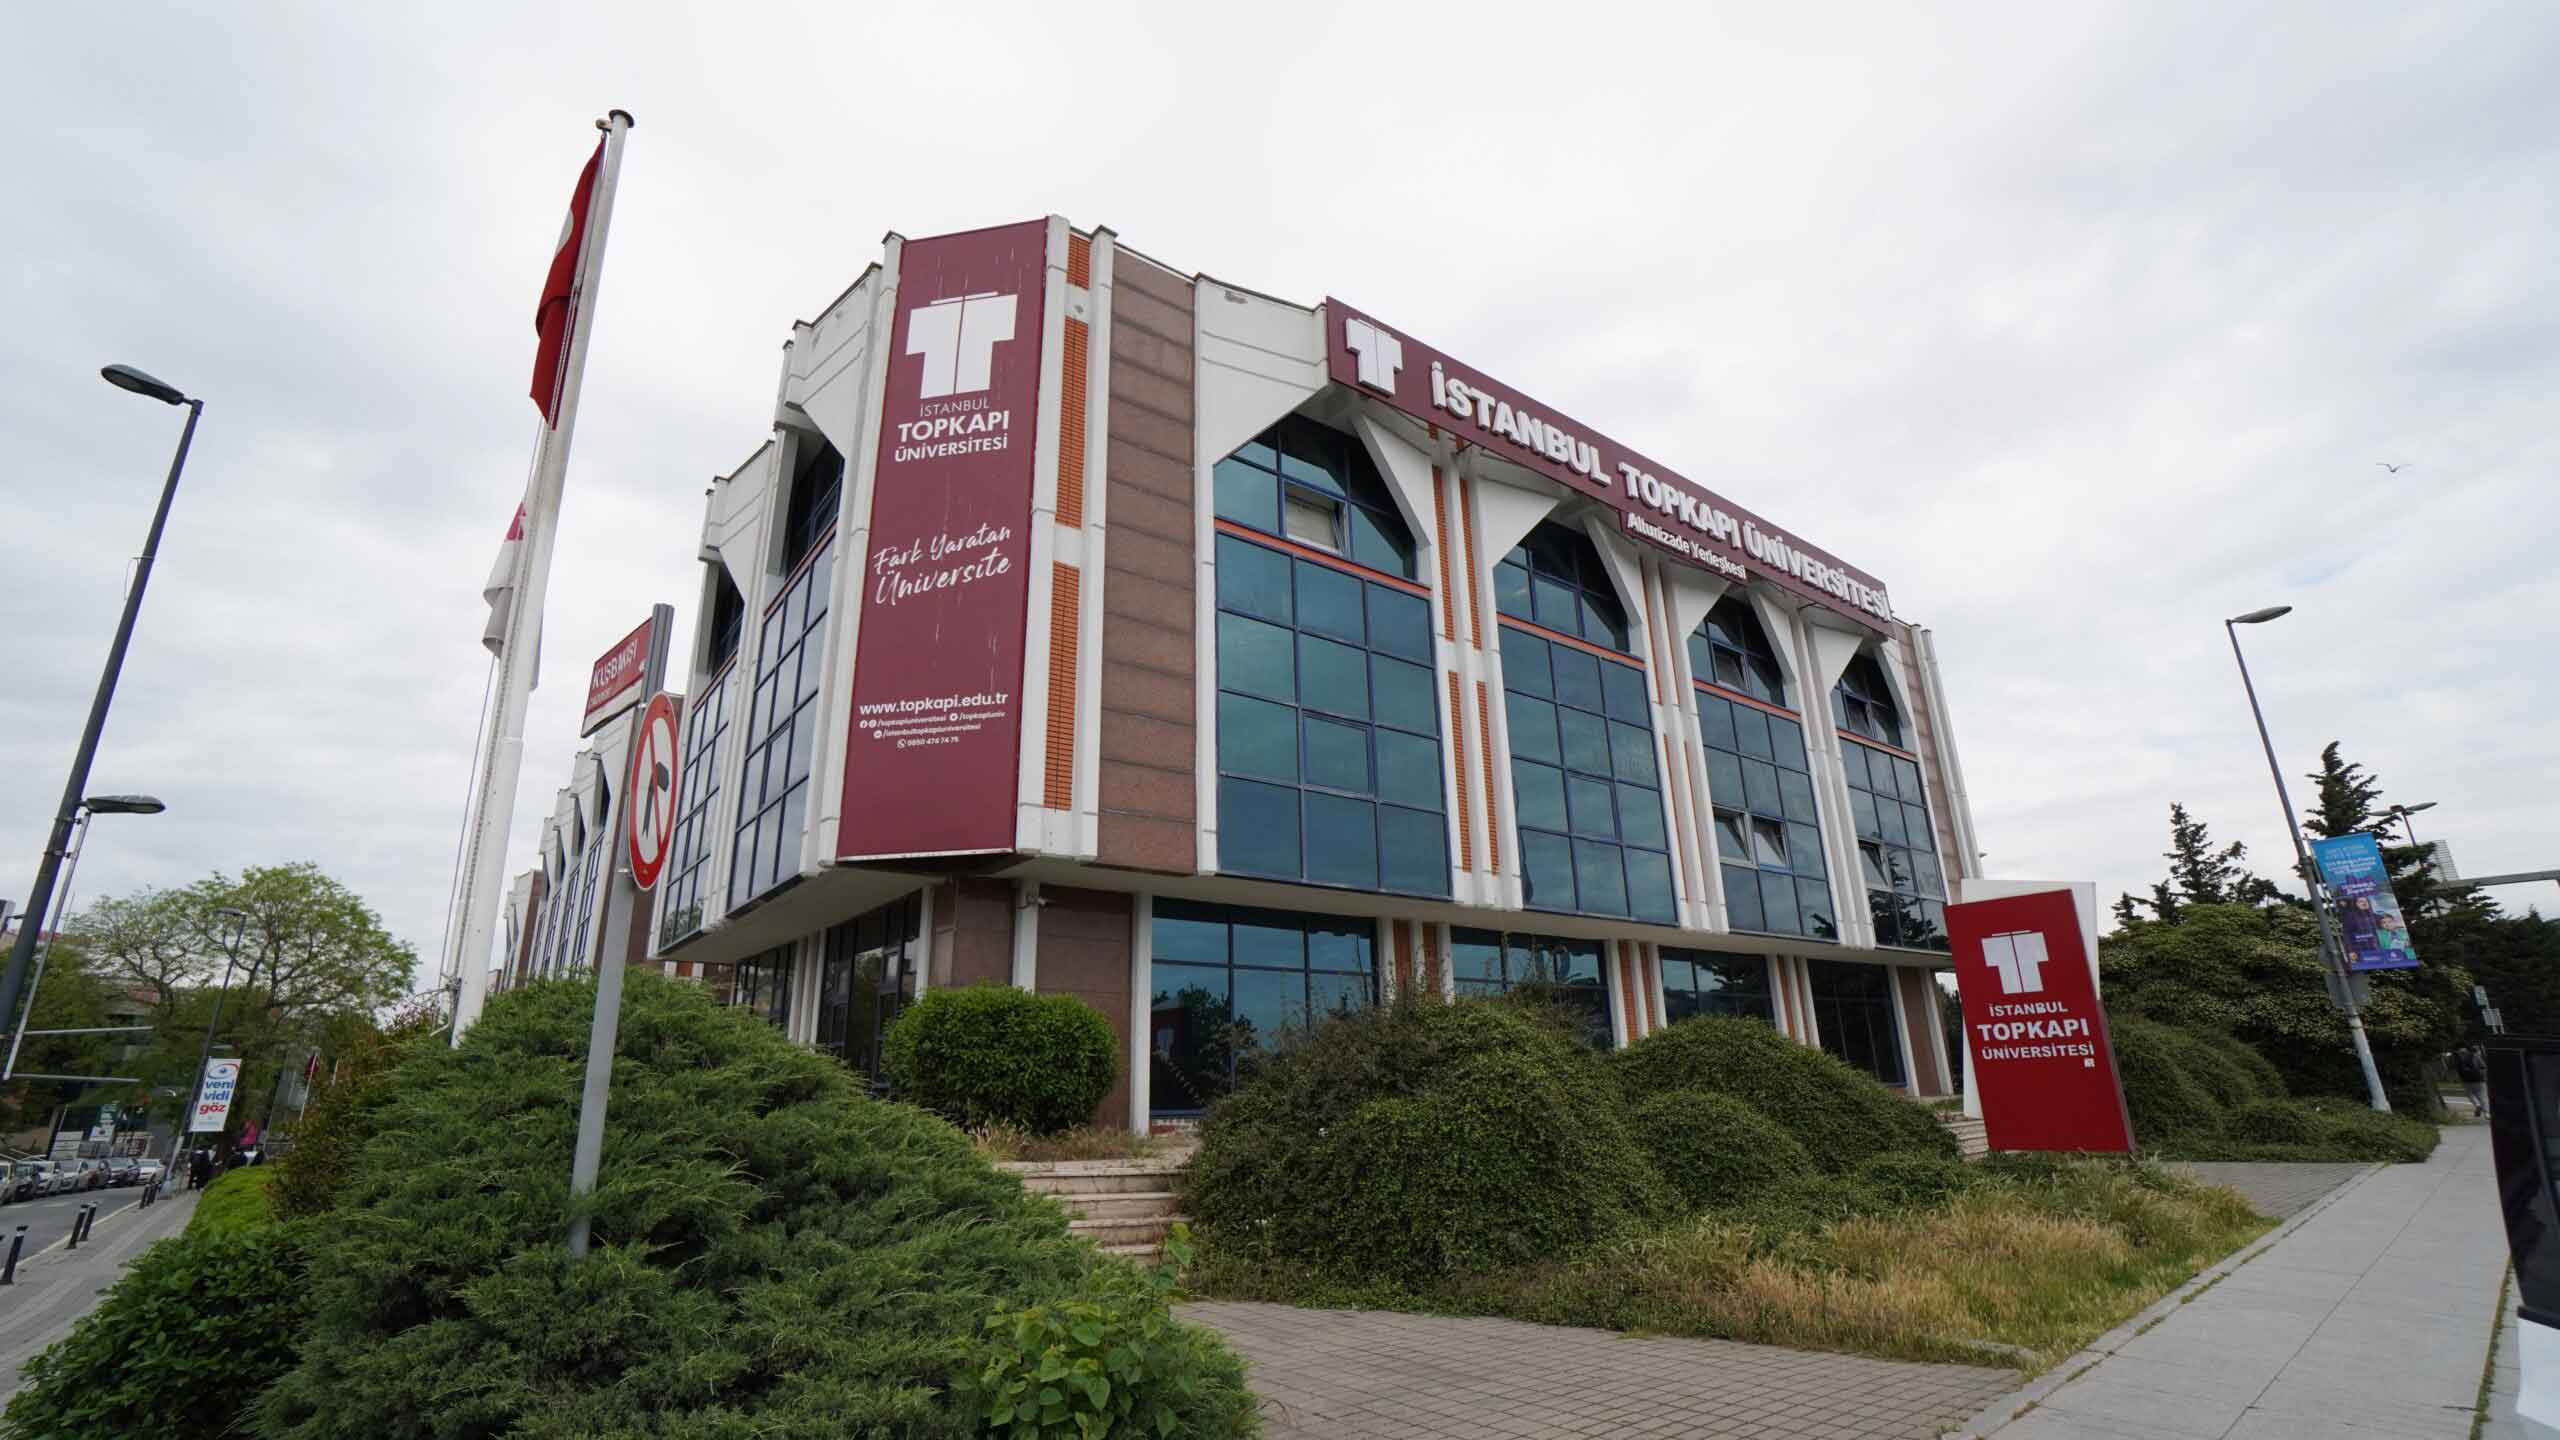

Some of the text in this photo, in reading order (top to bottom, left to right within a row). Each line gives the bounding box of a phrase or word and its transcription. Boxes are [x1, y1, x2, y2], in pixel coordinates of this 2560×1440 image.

[920, 397, 990, 417] İSTANBUL
[898, 410, 1010, 443] TOPKAPI
[895, 433, 1008, 462] ÜNİVERSİTESİ
[1431, 360, 1892, 622] İSTANBUL TOPKAPI ÜNİVERSİTESİ
[1626, 511, 1691, 554] Altunizade
[873, 522, 1011, 575] Fark Yaratan
[875, 547, 1011, 606] Üniversite
[859, 692, 1008, 715] www.topkapi.edu.tr
[1989, 1001, 2069, 1017] İSTANBUL
[1977, 1017, 2090, 1042] TOPKAPI
[1981, 1041, 2095, 1060] ÜNİVERSİTESİ
[204, 1090, 231, 1101] vidi
[206, 1079, 234, 1089] veni
[199, 1102, 226, 1115] göz
